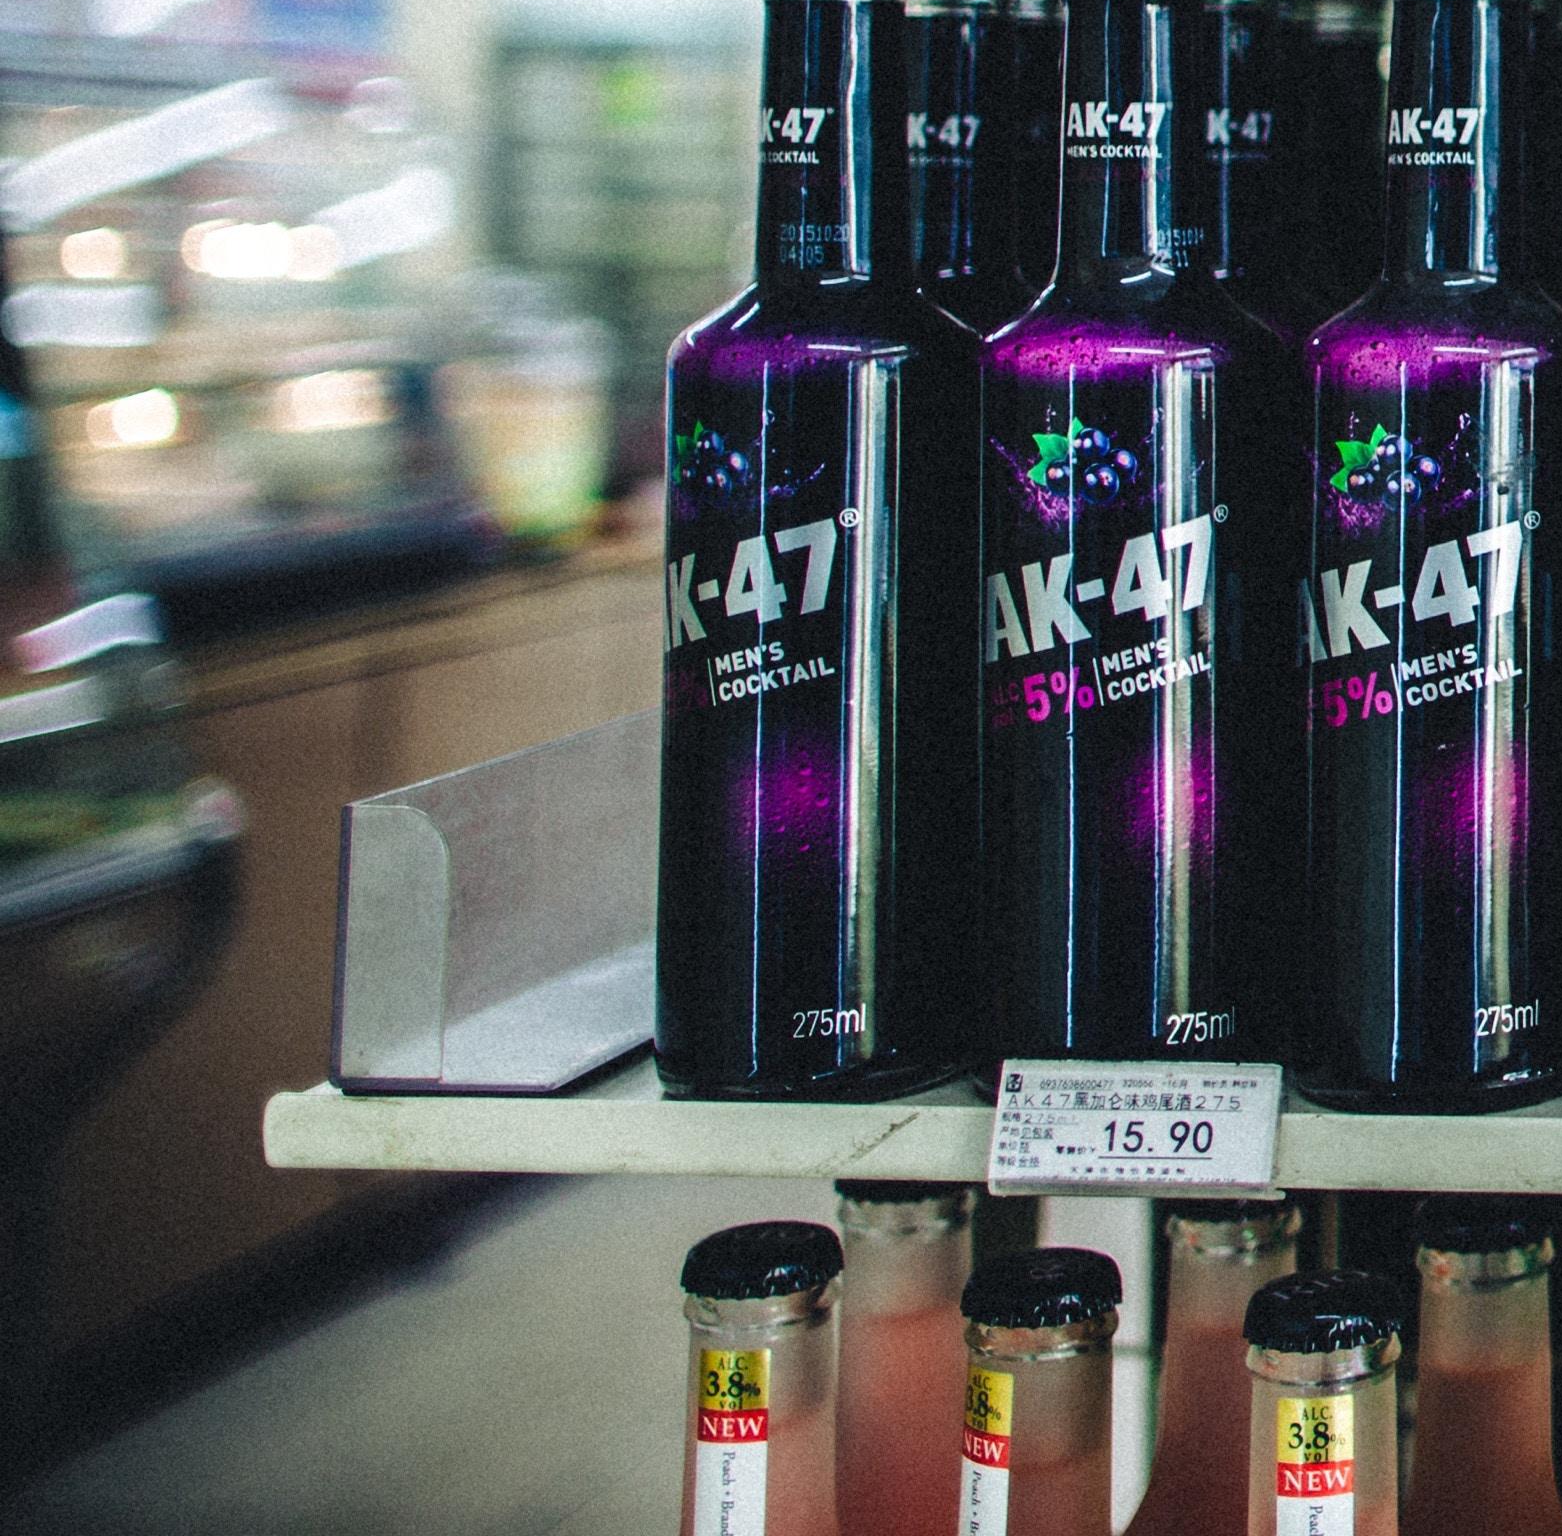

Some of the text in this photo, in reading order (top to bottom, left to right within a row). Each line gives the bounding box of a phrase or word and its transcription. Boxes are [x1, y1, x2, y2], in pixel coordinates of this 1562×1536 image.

[762, 107, 826, 144] K-47
[906, 111, 980, 150] K-47
[1066, 100, 1167, 139] AK-47
[1206, 107, 1273, 146] K-47
[1388, 107, 1480, 145] AK-47
[1100, 144, 1164, 159] COCKTAIL
[1414, 151, 1475, 165] COCKTAIL
[664, 519, 839, 654] K-47
[985, 513, 1214, 664] AK-47
[714, 641, 786, 675] MEN'S
[1101, 637, 1171, 676] MEN'S
[1106, 650, 1213, 702] COCKTAIL
[1401, 642, 1479, 681] MEN'S
[718, 658, 836, 703] COCKTAIL
[1023, 665, 1095, 725] 5%
[1322, 670, 1394, 728] 5%
[1406, 657, 1523, 707] COCKTAIL
[792, 1002, 867, 1039] 275ml
[1166, 1005, 1235, 1045] 275ml
[1475, 998, 1540, 1037] 275ml
[1103, 1120, 1215, 1154] 15.90
[702, 1415, 765, 1438] NEW
[964, 1431, 1006, 1461] NEW
[721, 1452, 736, 1488] Peach
[1283, 1468, 1351, 1492] NEW
